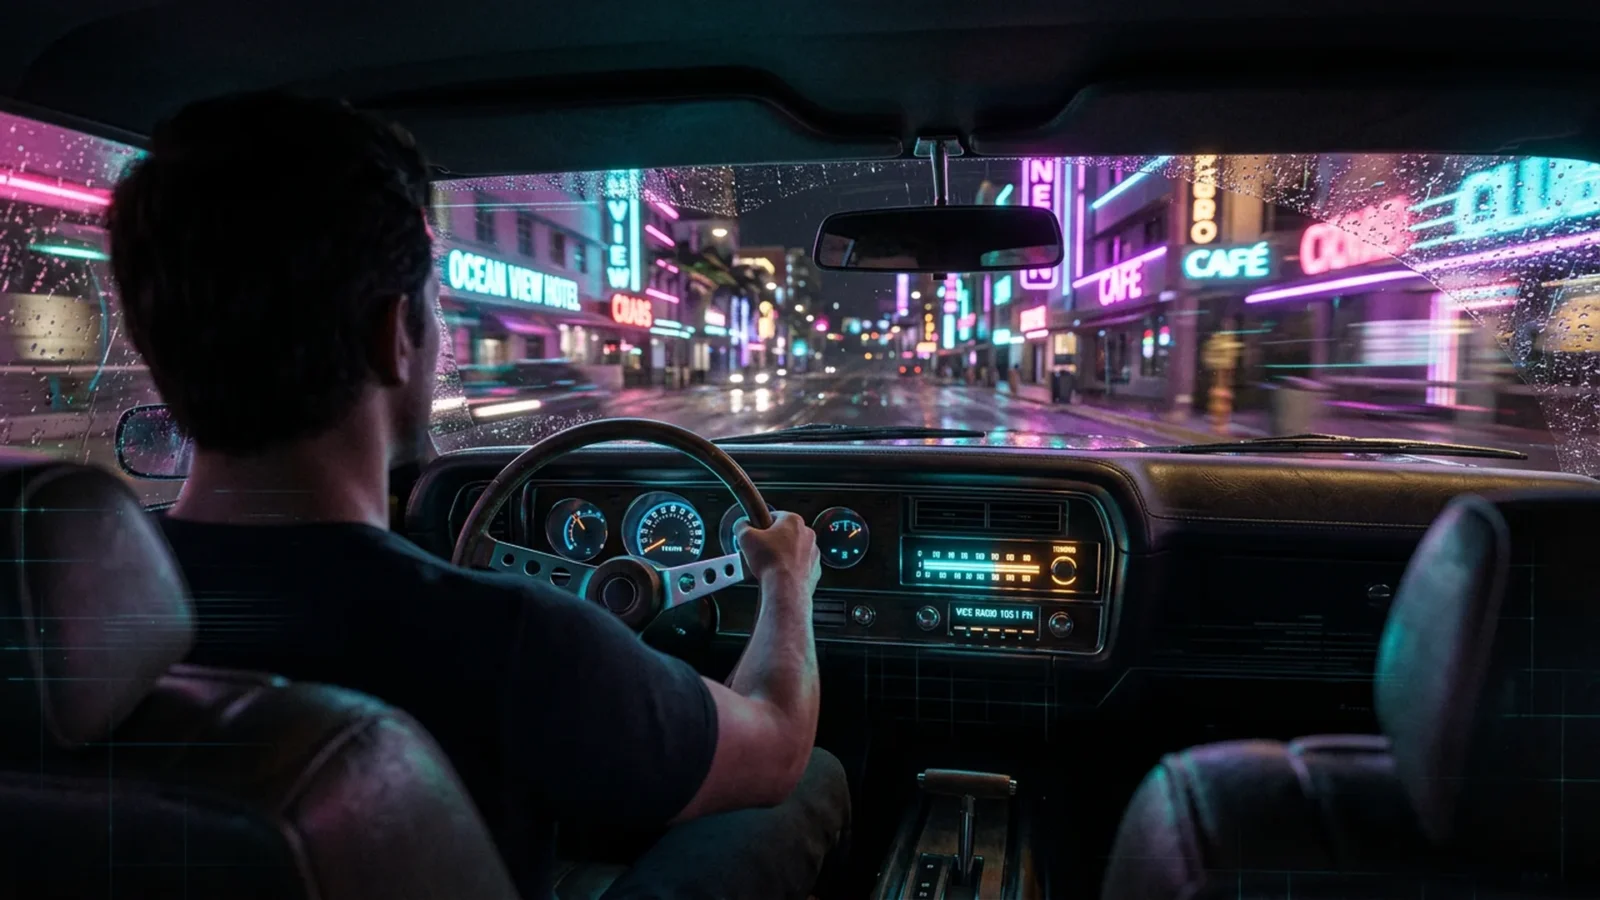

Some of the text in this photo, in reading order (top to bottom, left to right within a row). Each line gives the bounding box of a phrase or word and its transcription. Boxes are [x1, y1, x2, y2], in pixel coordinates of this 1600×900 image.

[449, 249, 581, 312] OCEAN VIEW HOTEL
[1184, 241, 1269, 278] CAFÉ
